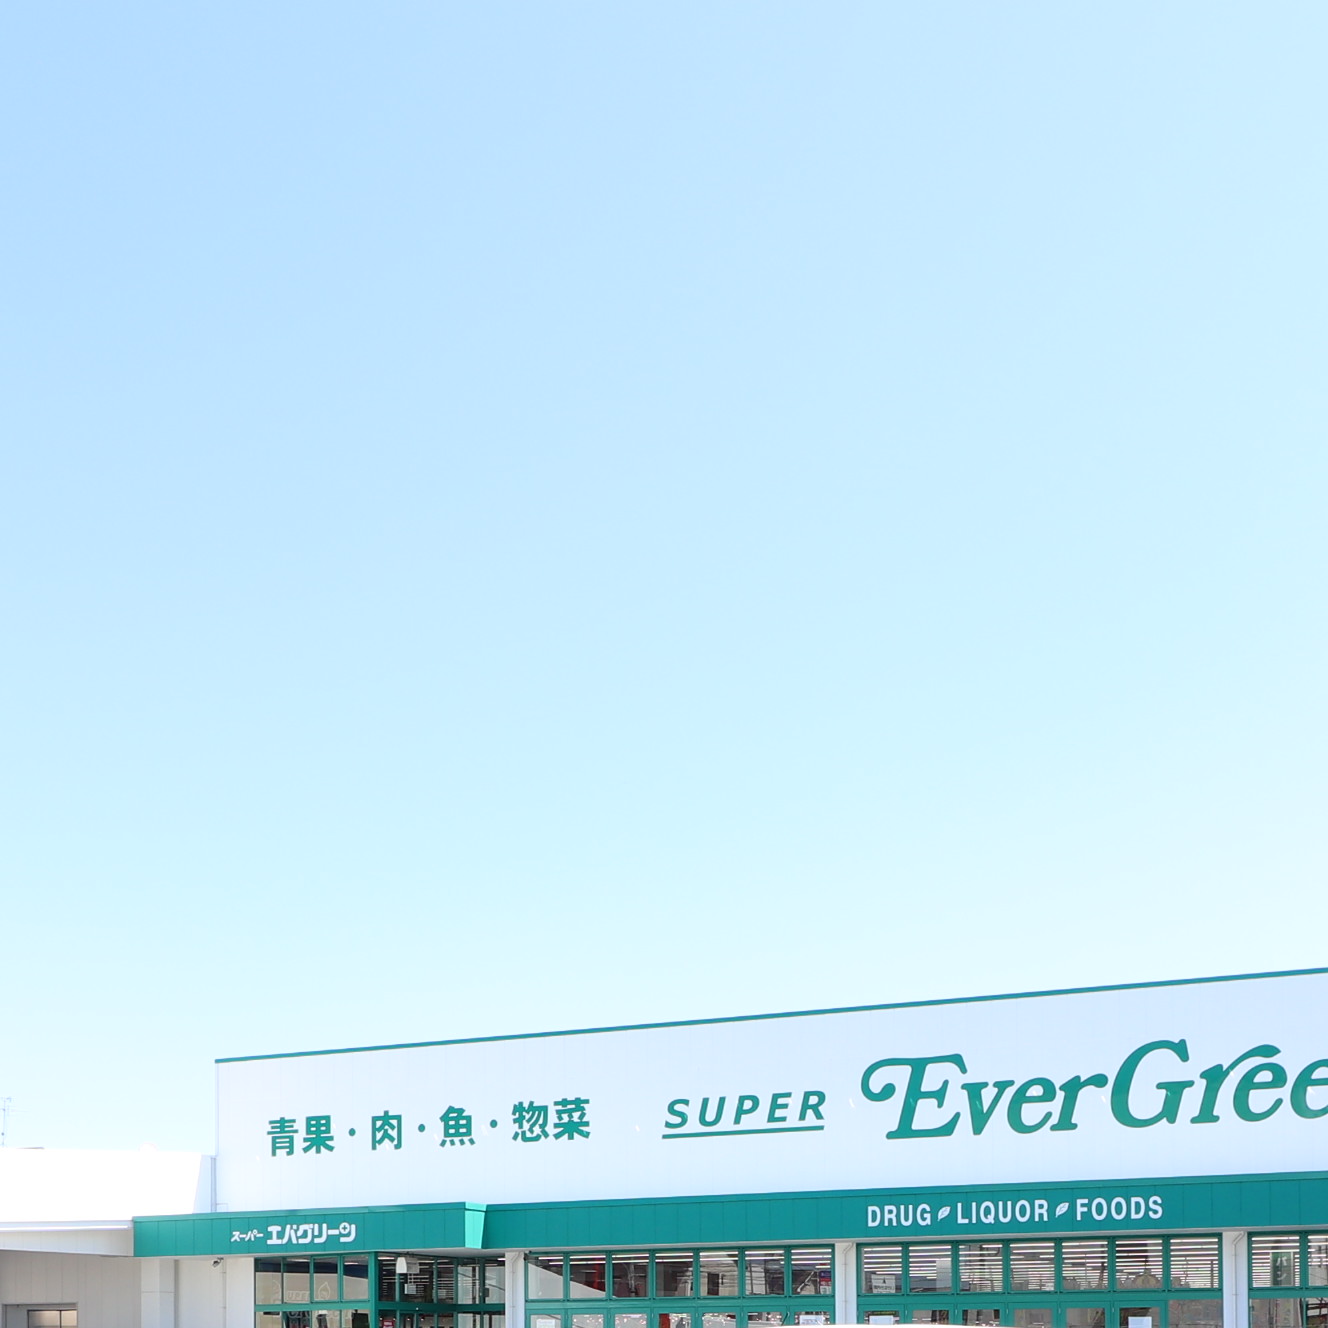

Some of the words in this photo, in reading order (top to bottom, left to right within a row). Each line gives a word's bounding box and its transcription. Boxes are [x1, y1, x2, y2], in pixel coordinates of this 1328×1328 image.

[266, 1097, 592, 1157] 青果・肉・魚・惣菜
[664, 1090, 826, 1130] SUPER
[868, 1203, 931, 1227] DRUG
[957, 1199, 1049, 1225] LIQUOR
[1076, 1195, 1164, 1221] FOODS
[230, 1229, 264, 1243] スーパー
[266, 1222, 356, 1245] エバグリーン
